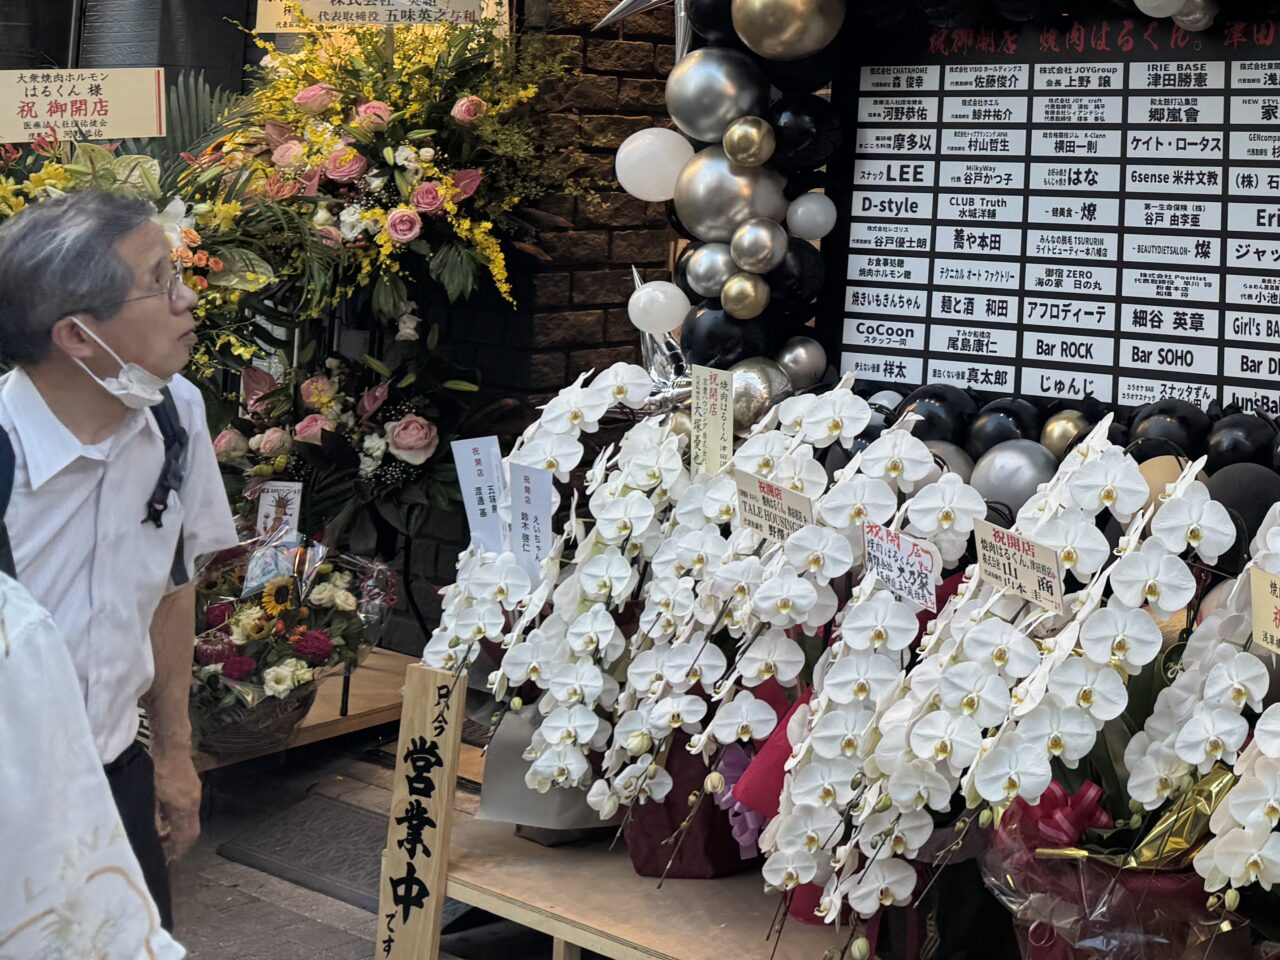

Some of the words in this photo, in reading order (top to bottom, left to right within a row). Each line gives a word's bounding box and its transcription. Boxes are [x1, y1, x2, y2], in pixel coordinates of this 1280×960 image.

[318, 11, 379, 21] 代表取締役
[17, 73, 109, 83] 大衆焼肉ホルモン
[975, 75, 1019, 88] 佐藤俊介
[1065, 76, 1091, 87] 上野
[1147, 73, 1208, 87] 津田勝憲
[25, 85, 81, 98] はるくん
[88, 84, 102, 97] 様
[17, 101, 38, 118] 祝
[47, 99, 109, 118] 御開店
[883, 106, 927, 120] 河野恭佑
[968, 140, 1009, 151] 村山哲生
[1054, 140, 1097, 153] 横田一則
[1131, 136, 1221, 152] ケイト・ロータス
[860, 171, 883, 180] スナック
[886, 164, 924, 182] LEE
[964, 173, 1013, 185] 谷戸かつ子
[1068, 168, 1098, 186] はな
[1131, 171, 1169, 184] 6sense
[1172, 171, 1218, 186] 米井文教
[862, 197, 918, 216] D-style
[950, 197, 974, 206] CLUB
[980, 198, 1006, 207] Truth
[958, 208, 996, 219] 水城洋輔
[1145, 213, 1164, 226] 谷戸
[874, 236, 926, 249] 谷戸優士朗
[940, 268, 964, 280] テクニカル
[967, 271, 981, 281] オート
[985, 270, 1015, 283] ファクトリー
[1045, 268, 1063, 278] 御宿
[1067, 270, 1092, 279] ZERO
[1035, 278, 1063, 288] 海の家
[1074, 280, 1102, 291] 日の丸
[852, 291, 921, 310] 焼きいもきんちゃん
[941, 295, 974, 316] 麺と酒
[986, 298, 1008, 318] 和田
[1028, 301, 1106, 323] アフロディーテ
[1132, 308, 1163, 329] 細谷
[1172, 311, 1205, 332] 英章
[856, 323, 914, 338] CoCoon
[1233, 318, 1260, 337] Girl's
[864, 336, 906, 346] スタッフ一同
[947, 337, 997, 354] 尾島康仁
[1037, 339, 1056, 357] Bar
[1061, 342, 1093, 359] ROCK
[1132, 346, 1152, 364] Bar
[1158, 348, 1193, 367] SOHO
[1241, 355, 1262, 374] Bar
[883, 360, 906, 379] 祥太
[967, 368, 1008, 386] 真太郎
[1040, 375, 1094, 396] じゅんじ
[742, 501, 763, 518] TALE
[432, 685, 451, 737] 只今
[389, 735, 444, 925] 営業中
[382, 910, 398, 959] です
